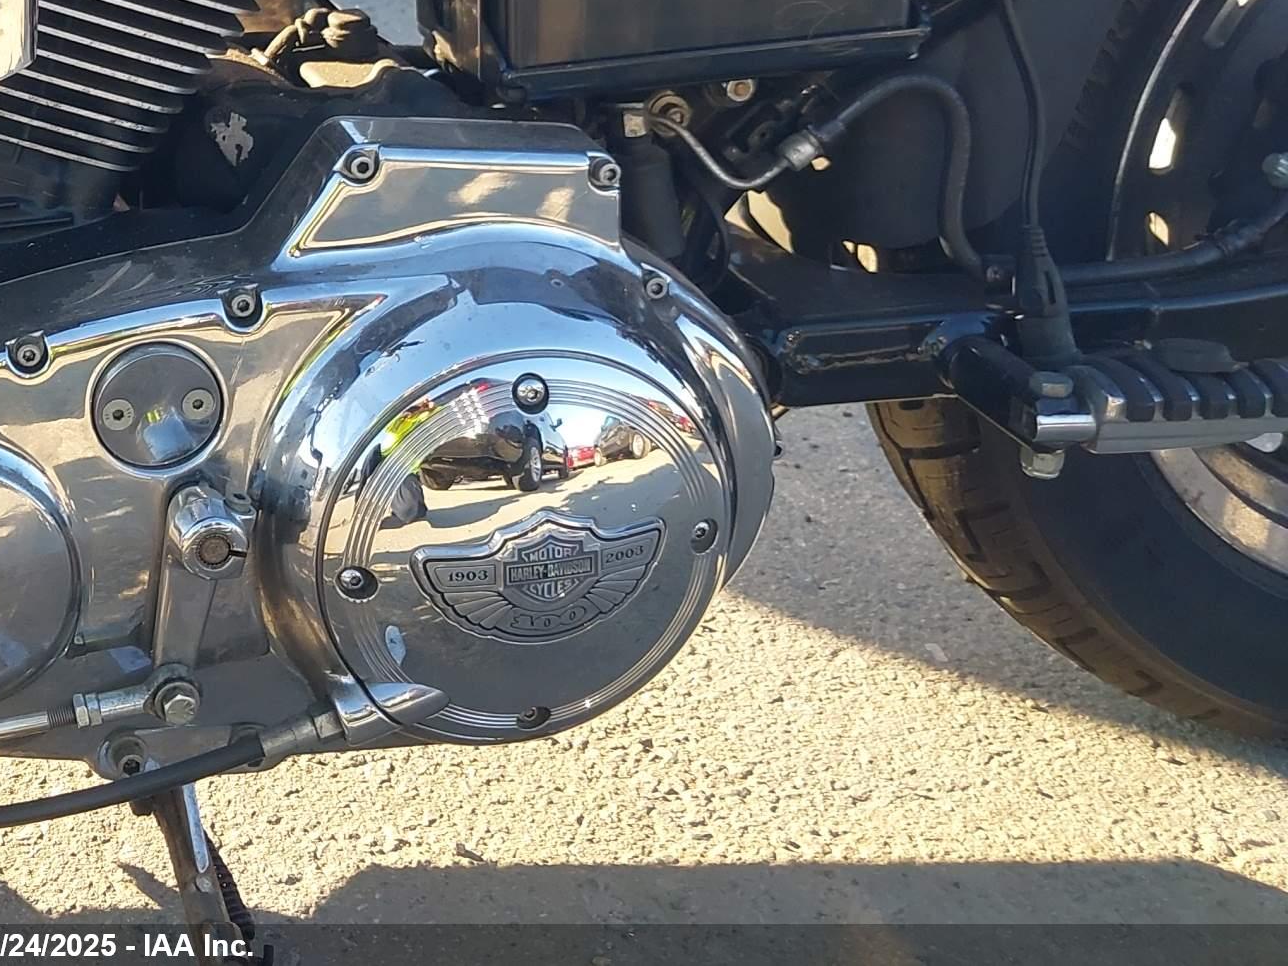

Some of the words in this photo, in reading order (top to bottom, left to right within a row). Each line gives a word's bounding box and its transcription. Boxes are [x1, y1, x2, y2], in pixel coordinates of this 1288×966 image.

[528, 545, 572, 562] MOTOR
[604, 544, 645, 564] 2003
[447, 570, 489, 583] 1903
[511, 558, 592, 581] HARLEY-DAVIDSON
[529, 580, 573, 599] CYCLES
